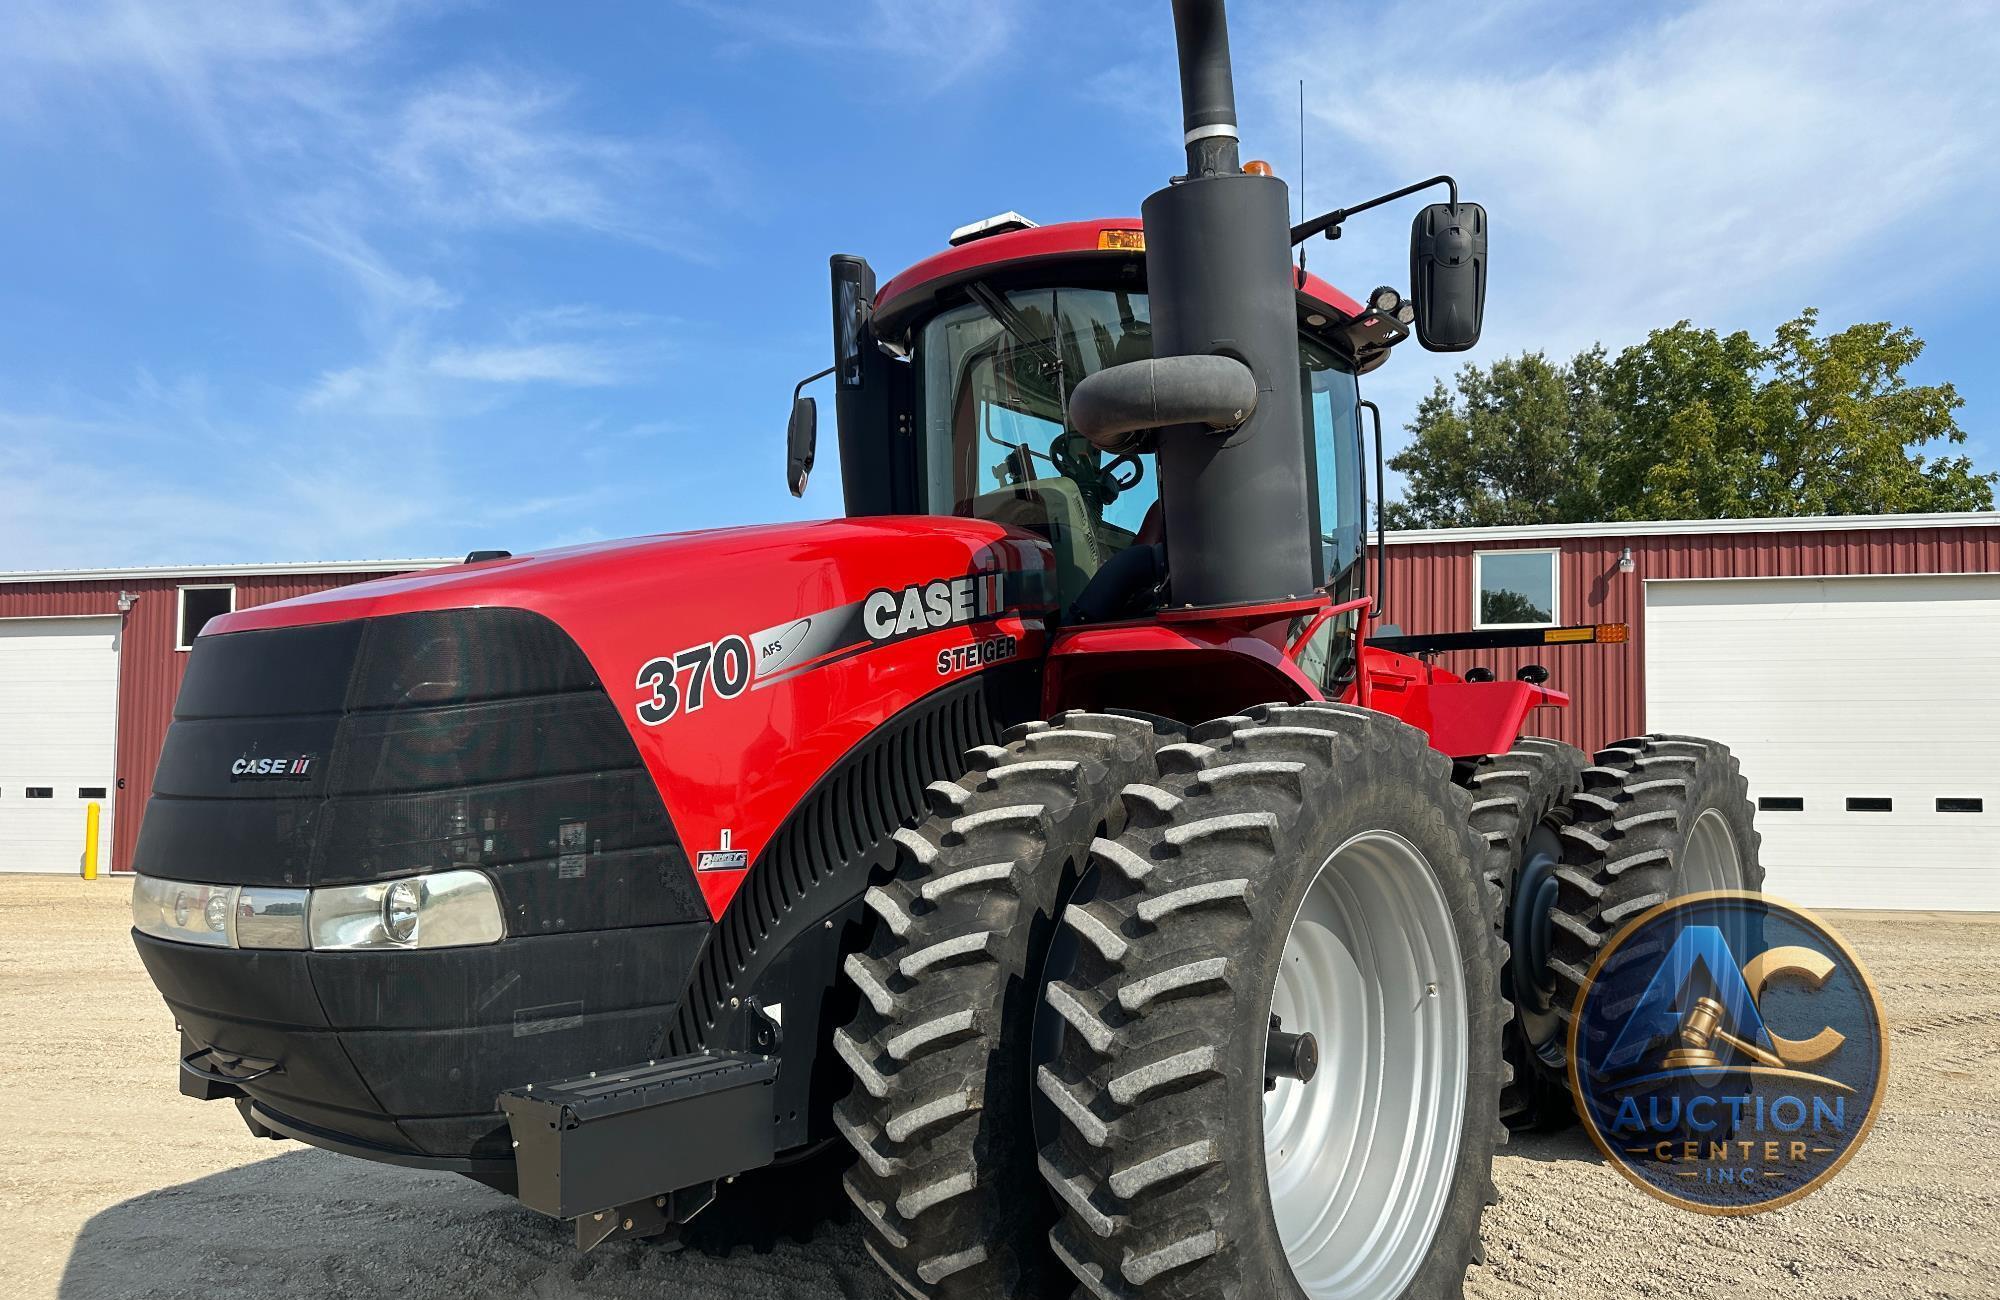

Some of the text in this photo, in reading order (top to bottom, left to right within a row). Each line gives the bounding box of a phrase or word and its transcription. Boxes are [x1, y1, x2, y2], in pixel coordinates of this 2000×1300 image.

[863, 577, 975, 640] CASE
[762, 640, 783, 659] AFS
[936, 634, 1018, 676] STEIGER
[635, 634, 751, 727] 370
[231, 758, 288, 775] CASE
